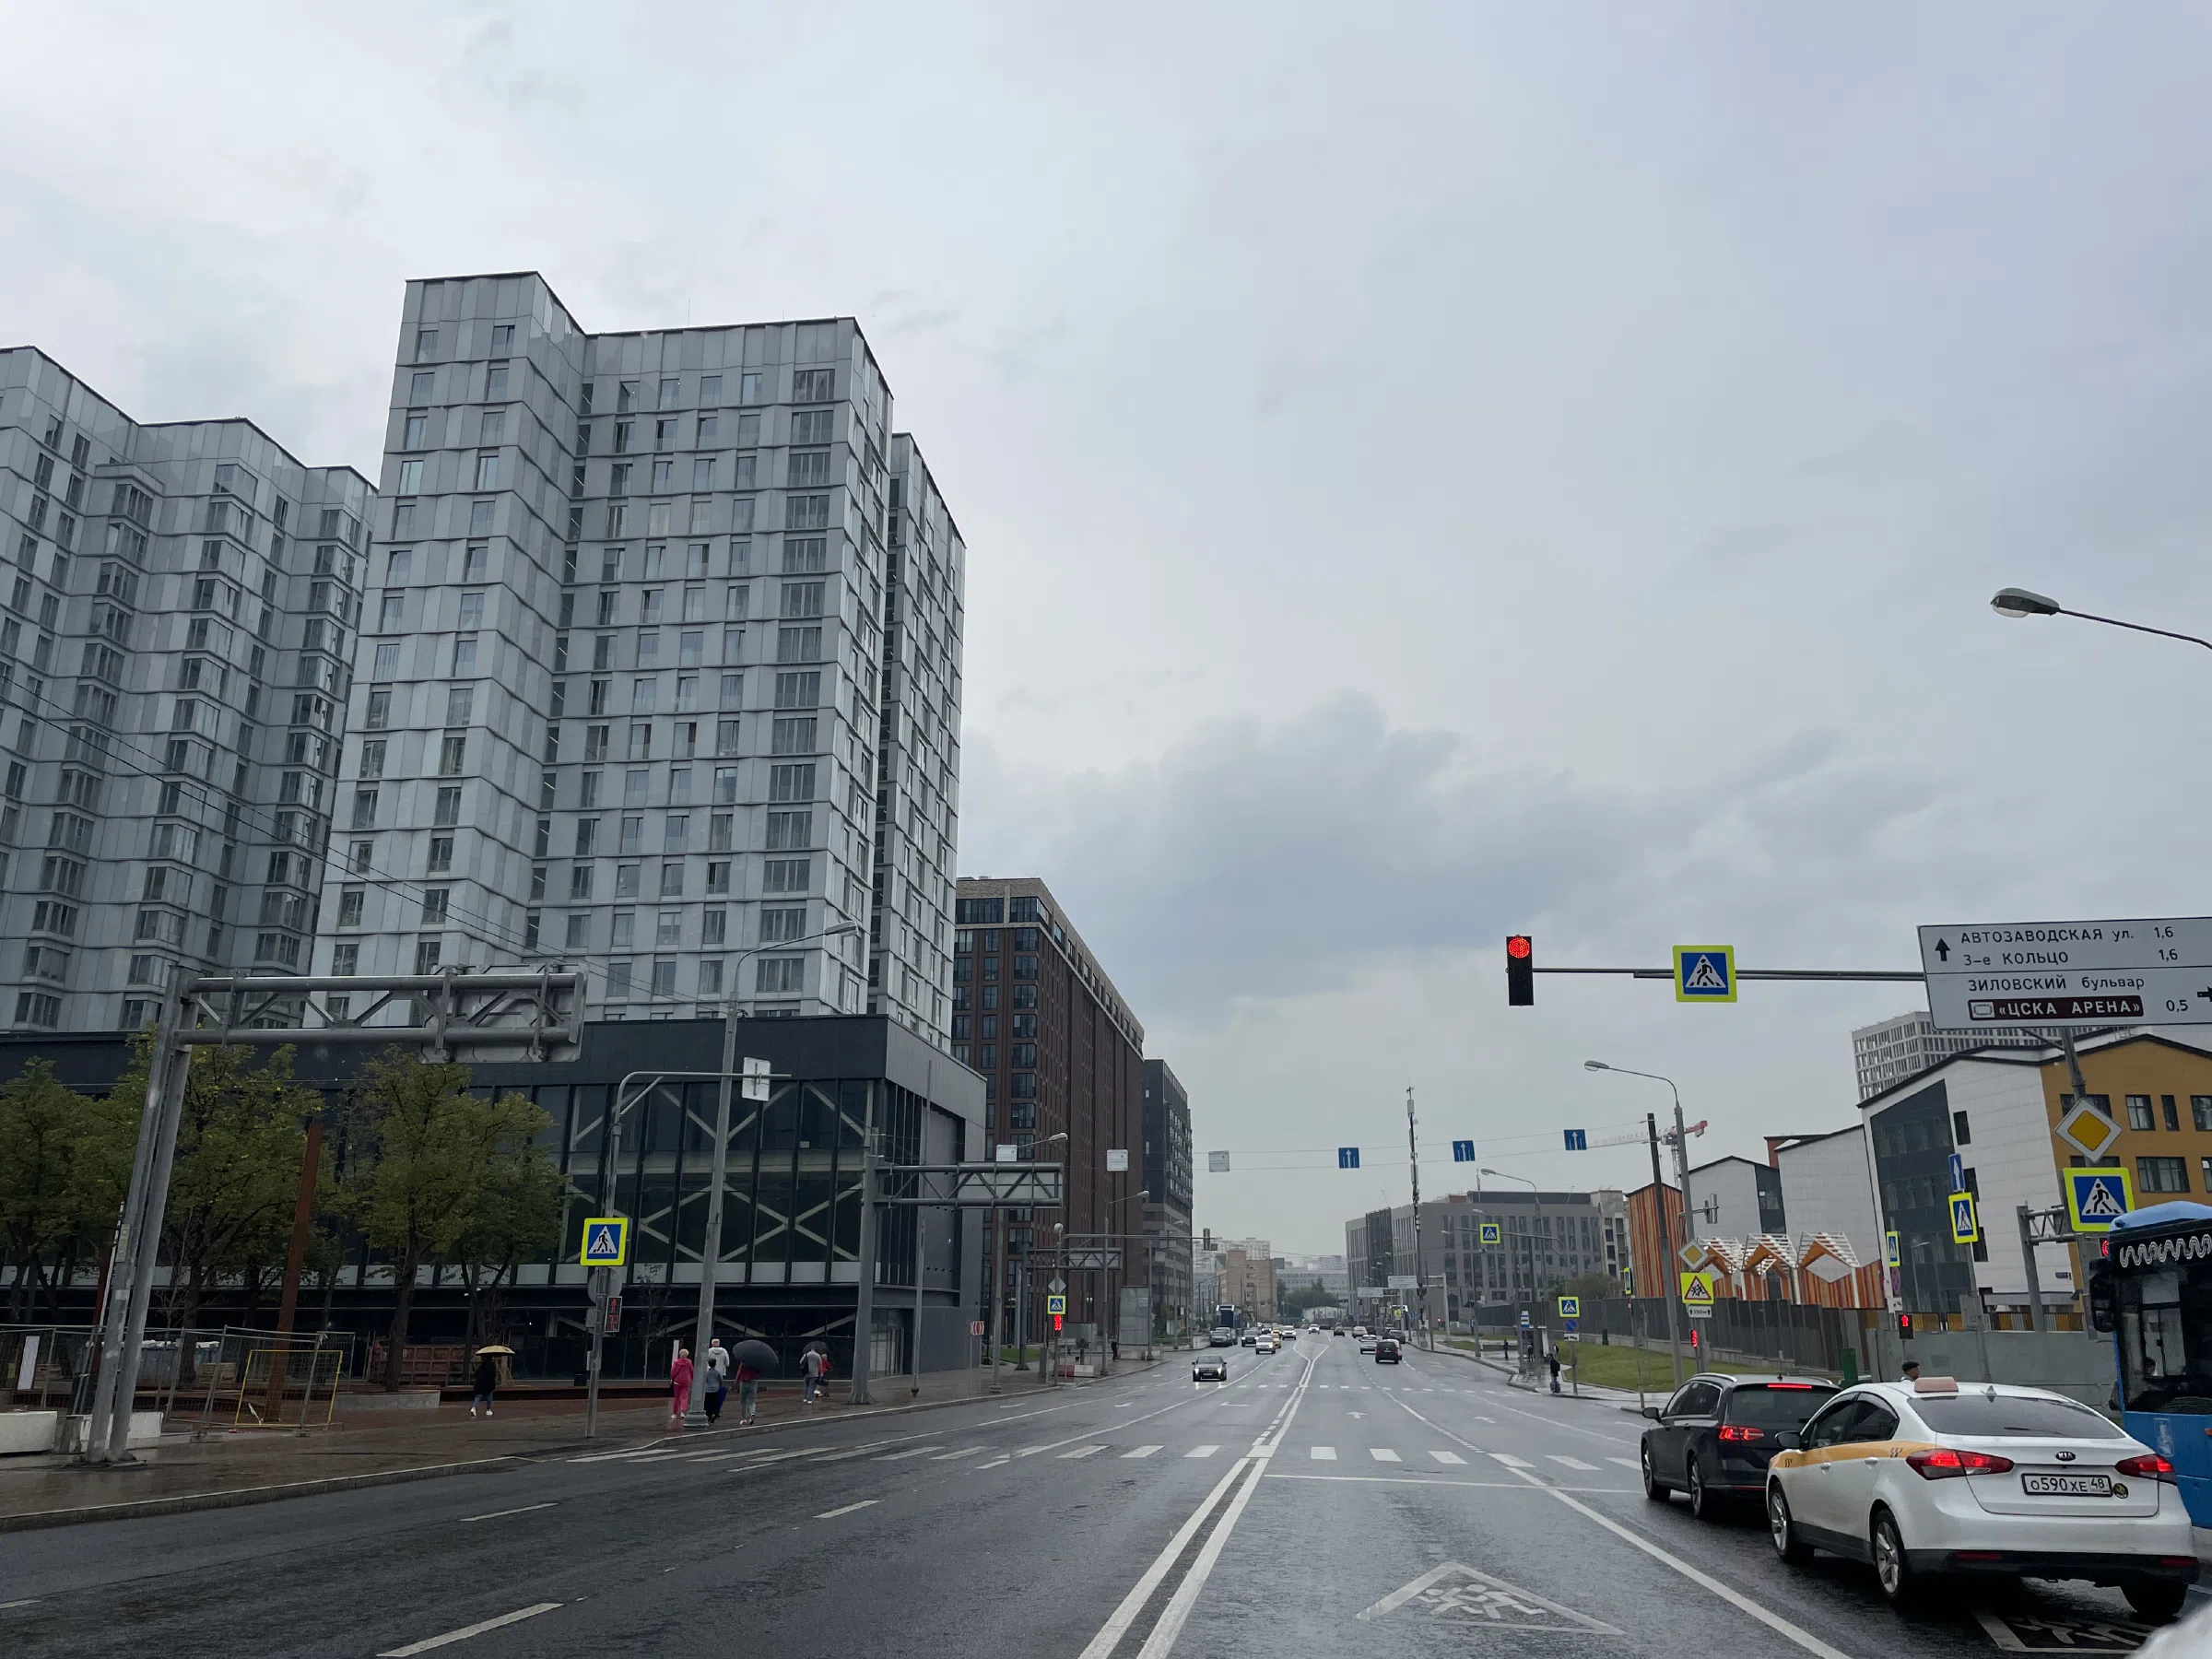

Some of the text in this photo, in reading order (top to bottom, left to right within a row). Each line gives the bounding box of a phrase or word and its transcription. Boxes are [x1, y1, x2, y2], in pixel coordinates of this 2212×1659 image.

[1960, 925, 2174, 944] АВТОЗАВОДСКАЯ ул. 1,6
[2002, 951, 2069, 965] КОЛЬЦО
[2158, 948, 2179, 962] 1,6
[1968, 974, 2145, 992] ЗИЛОВСКИЙ бульвар
[1998, 1000, 2140, 1018] «ЦСКА АРЕНА»
[2165, 999, 2189, 1014] 0,5
